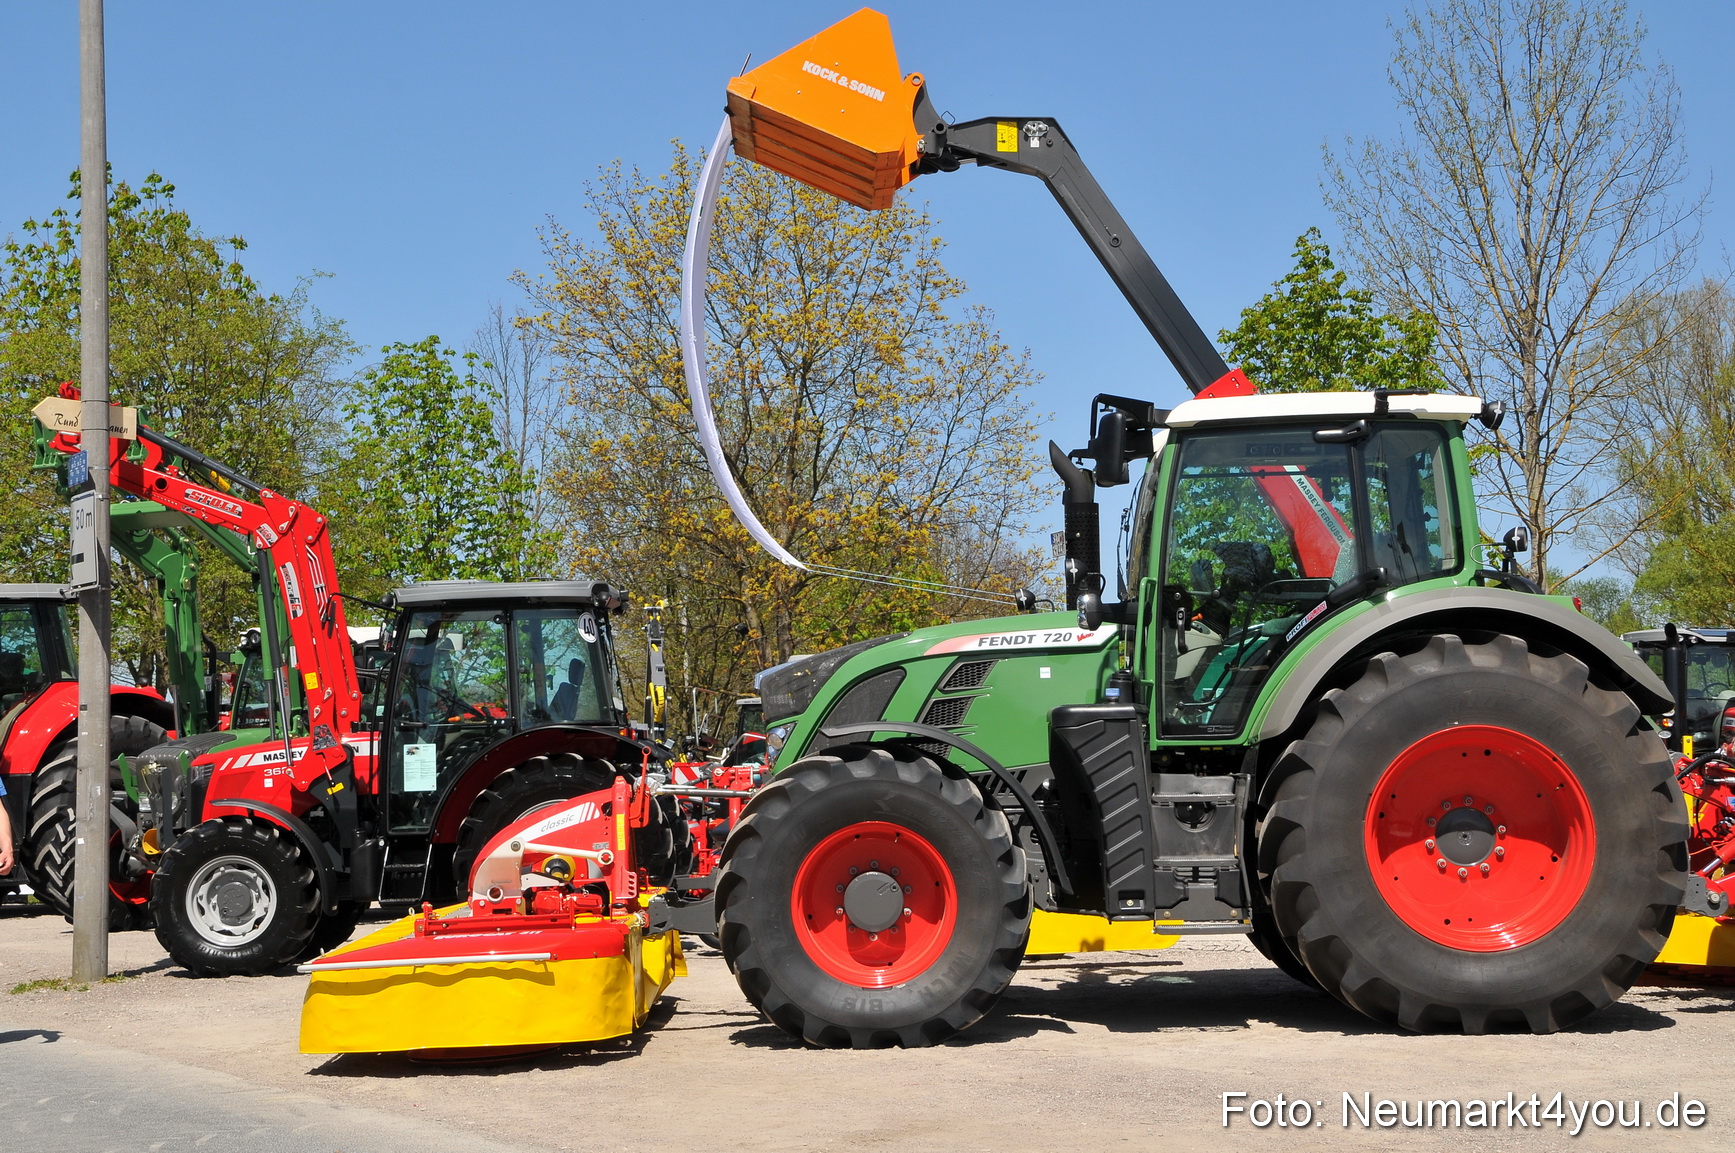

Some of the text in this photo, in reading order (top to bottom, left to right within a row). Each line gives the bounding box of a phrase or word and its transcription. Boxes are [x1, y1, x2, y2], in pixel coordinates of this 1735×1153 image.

[802, 60, 839, 84] KOCK
[849, 79, 885, 102] SOHN
[109, 425, 128, 434] auen
[1296, 477, 1320, 508] MASSEY
[187, 490, 240, 516] STOLL
[583, 617, 595, 637] 40
[978, 634, 1037, 647] FENDT
[1043, 632, 1073, 644] 720
[263, 750, 304, 762] MASEY
[540, 813, 575, 833] classic
[843, 996, 884, 1014] BIB
